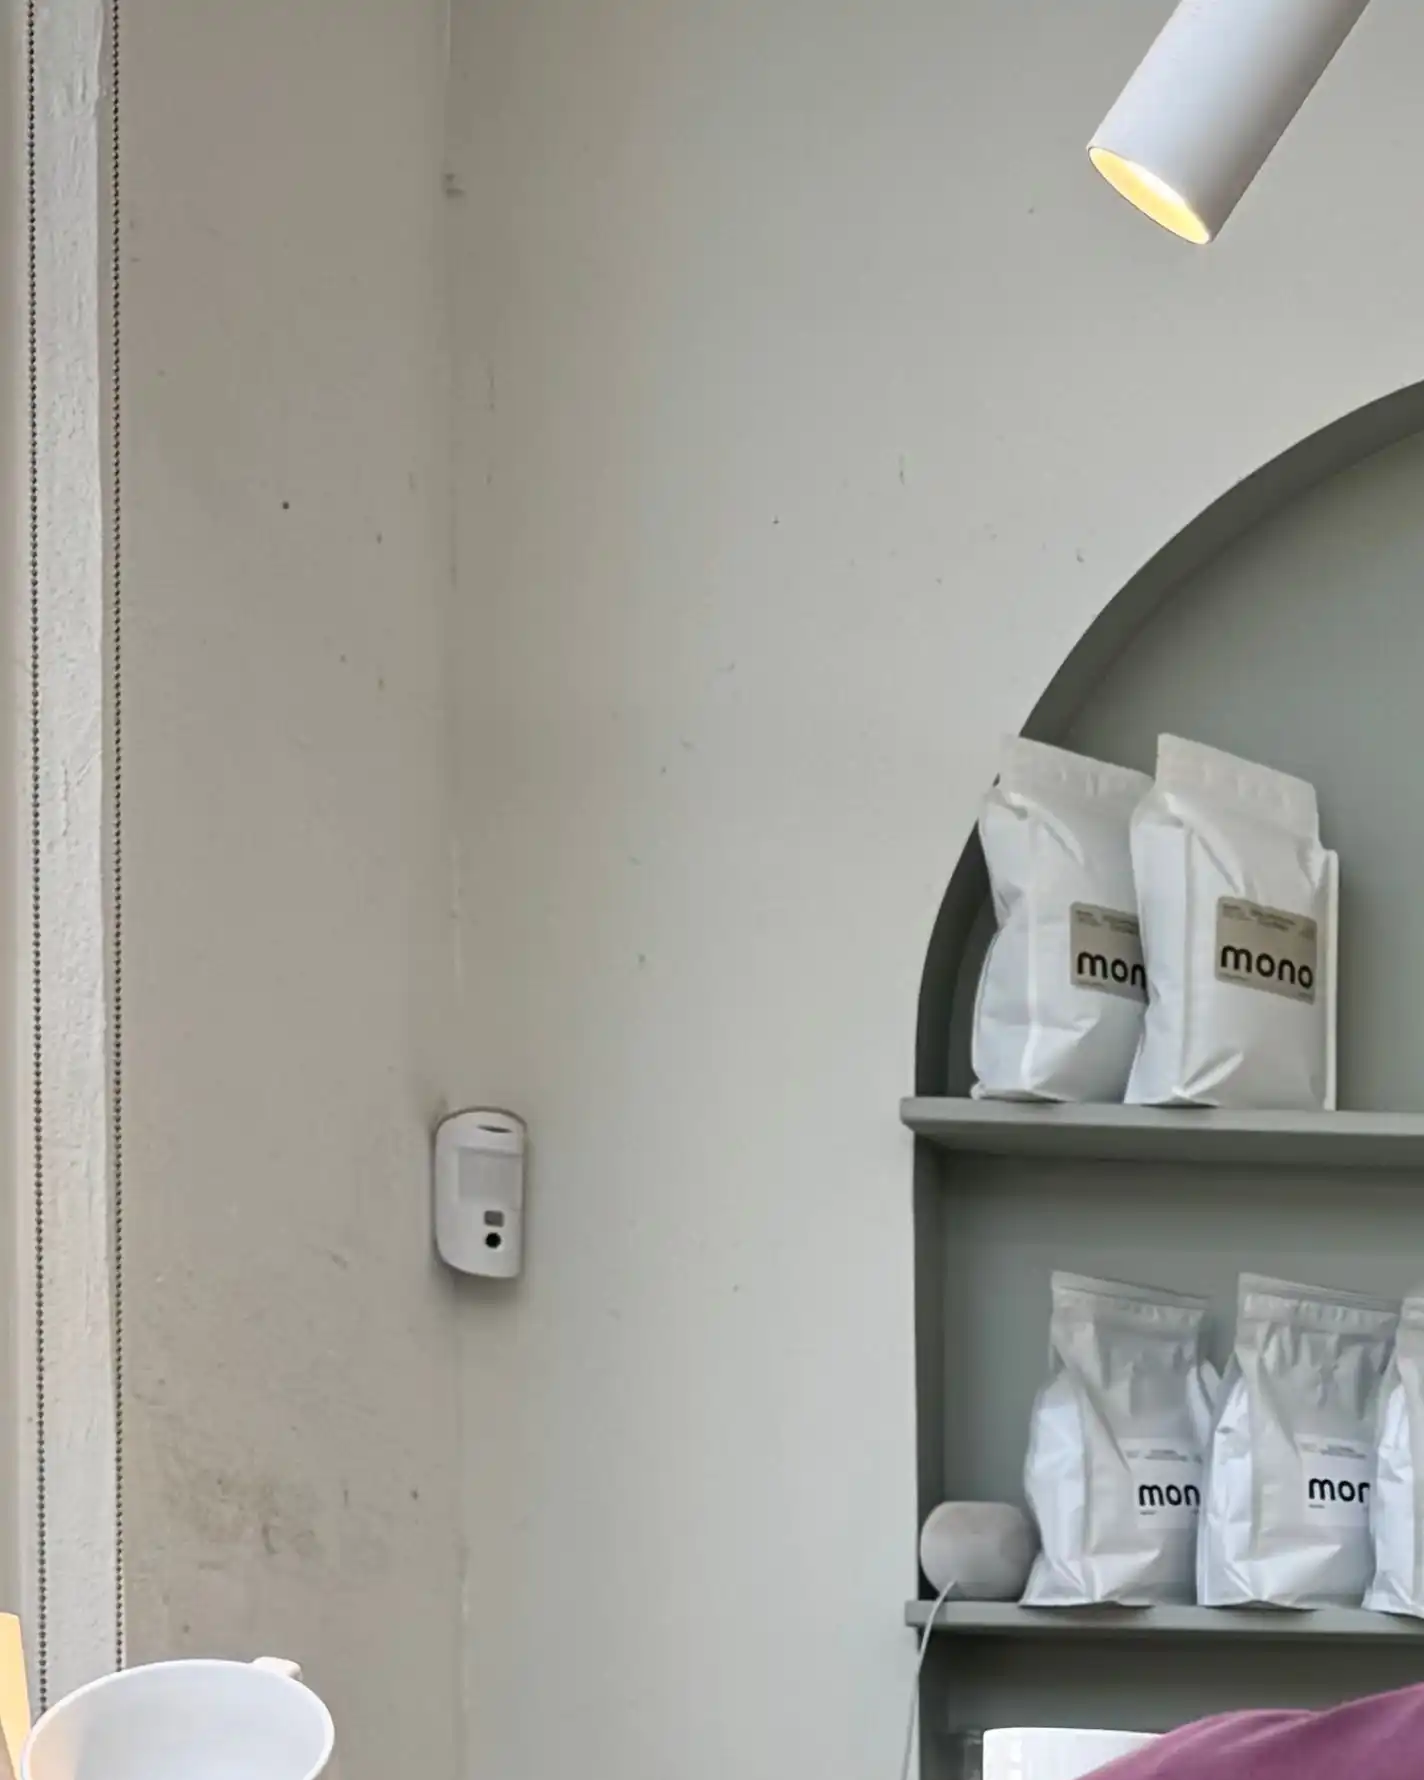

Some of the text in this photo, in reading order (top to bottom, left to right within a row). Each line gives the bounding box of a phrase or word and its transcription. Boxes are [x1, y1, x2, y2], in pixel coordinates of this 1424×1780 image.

[1077, 951, 1147, 992] mon
[1220, 944, 1314, 990] mono
[1138, 1484, 1201, 1507] mon
